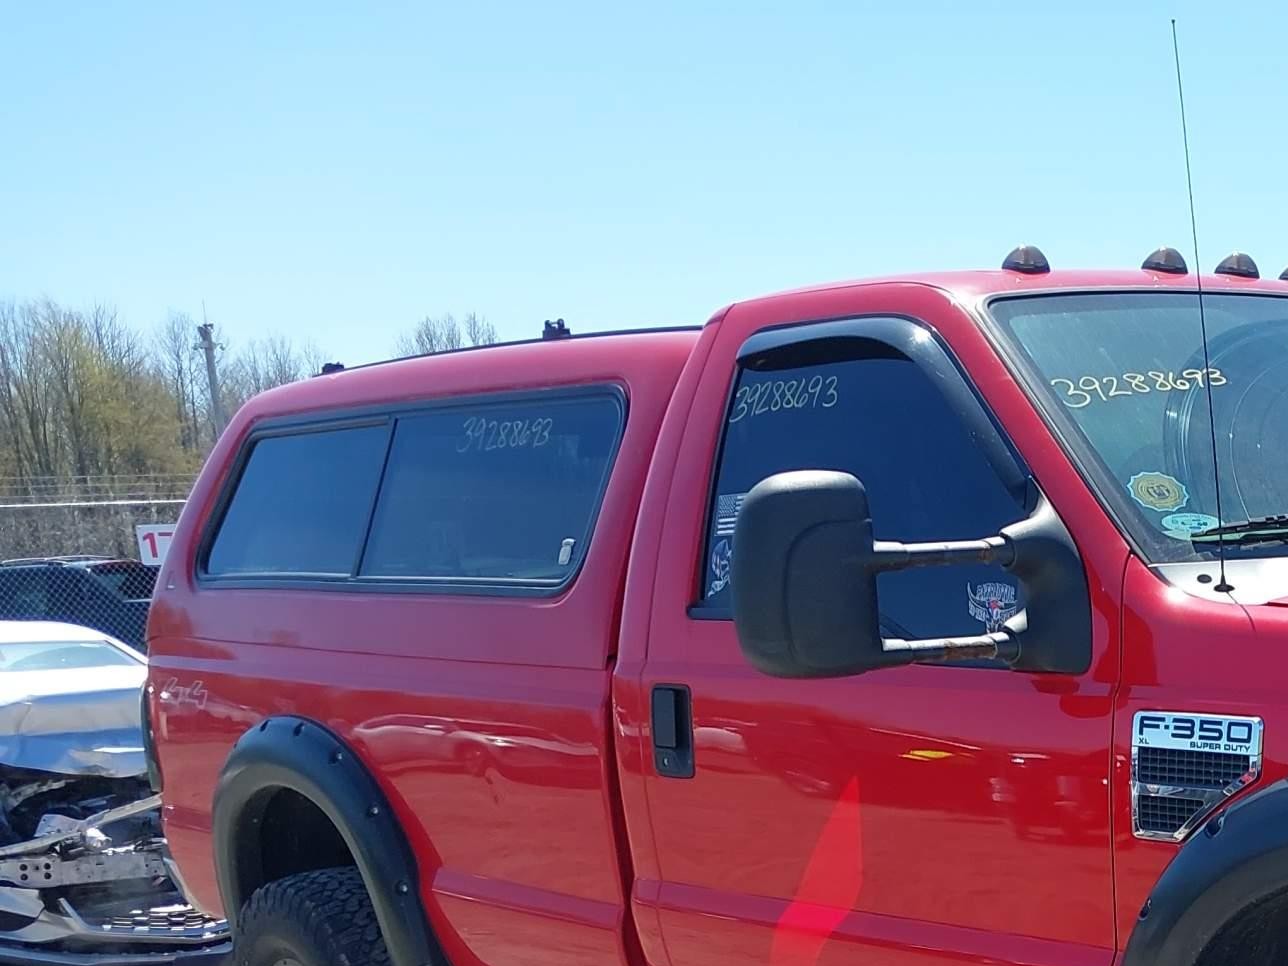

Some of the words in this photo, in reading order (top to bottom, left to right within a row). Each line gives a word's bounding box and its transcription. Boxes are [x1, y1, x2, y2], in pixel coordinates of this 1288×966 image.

[729, 375, 838, 423] 39288693
[1050, 368, 1227, 408] 39288693
[456, 416, 553, 453] 39288693
[142, 531, 174, 558] 1
[1138, 737, 1149, 745] XL
[1189, 741, 1221, 751] SUPER
[1223, 743, 1251, 753] DUTY
